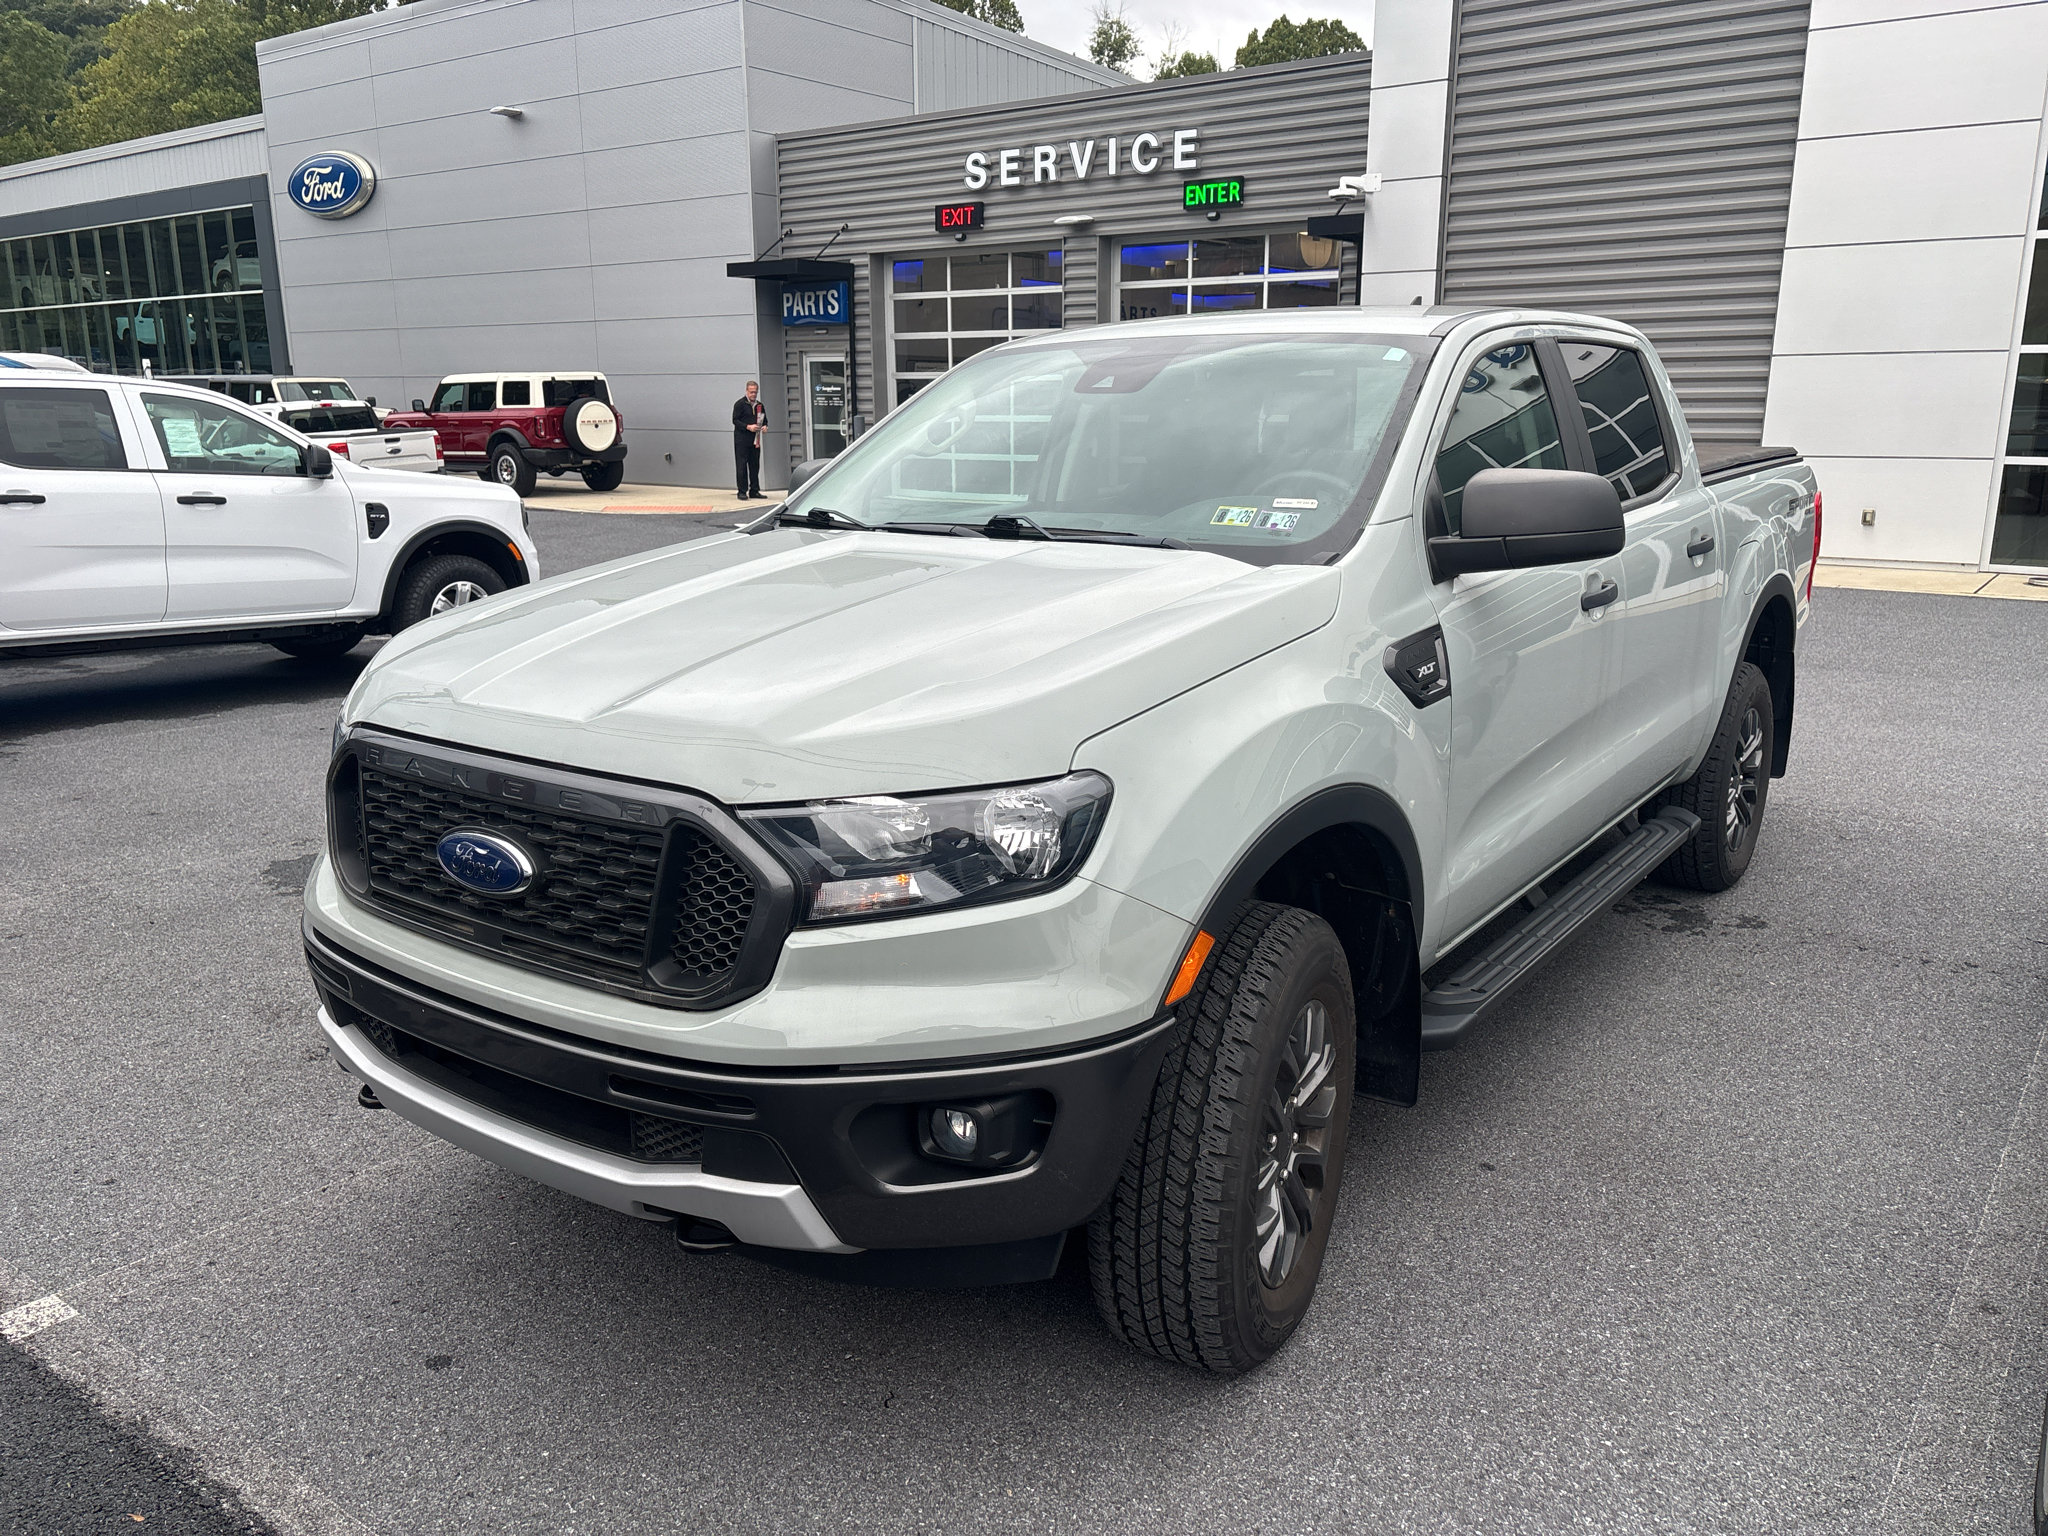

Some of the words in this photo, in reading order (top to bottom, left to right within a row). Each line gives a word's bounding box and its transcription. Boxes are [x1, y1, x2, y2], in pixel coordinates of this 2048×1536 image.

[963, 128, 1198, 190] SERVICE
[301, 166, 345, 203] Ford
[1184, 181, 1240, 206] ENTER
[941, 206, 975, 227] EXIT
[783, 289, 839, 317] PARTS
[1417, 661, 1436, 678] XLT
[365, 746, 648, 823] RANGER
[450, 841, 501, 883] Ford
